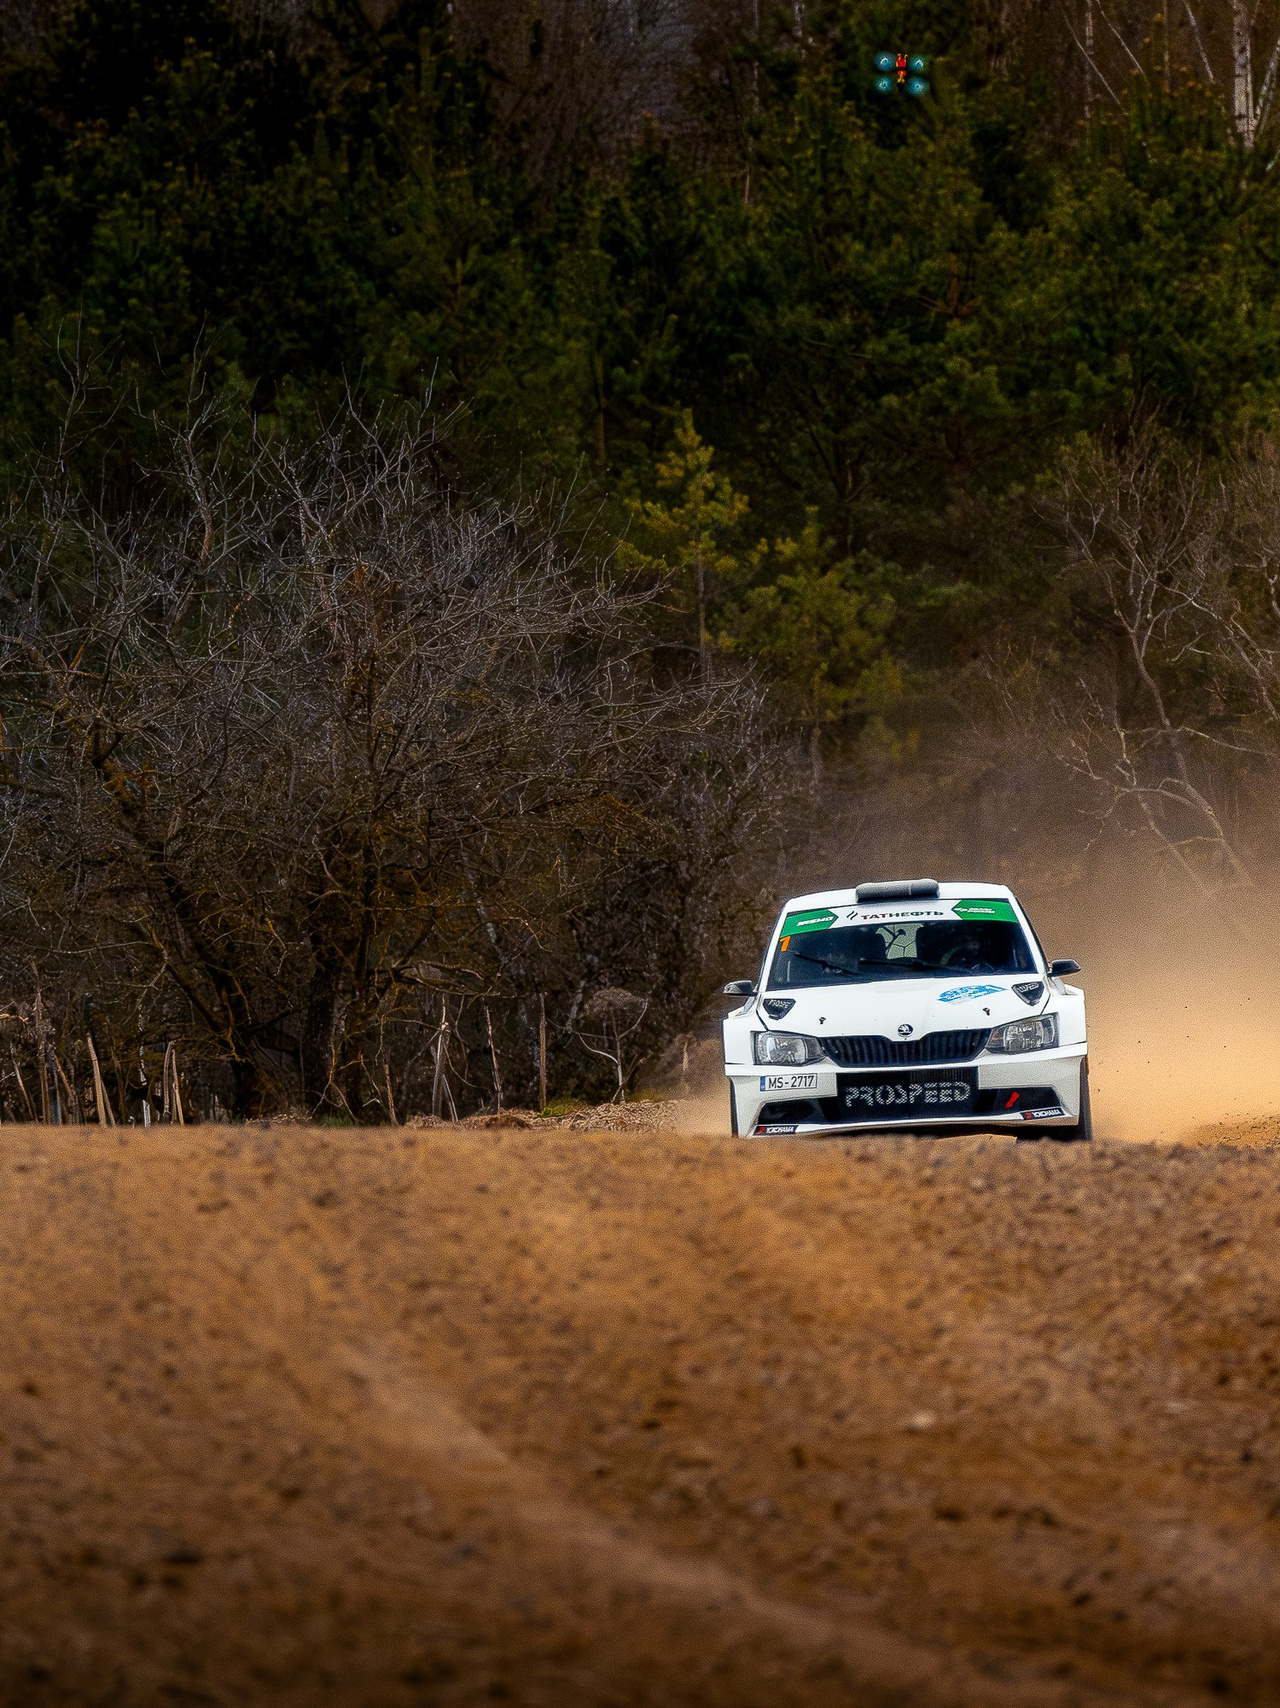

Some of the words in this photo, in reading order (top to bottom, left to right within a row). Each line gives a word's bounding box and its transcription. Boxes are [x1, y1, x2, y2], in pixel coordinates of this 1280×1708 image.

[780, 936, 791, 952] 1
[767, 1076, 815, 1089] MS-2717
[845, 1081, 971, 1107] PROSPEED
